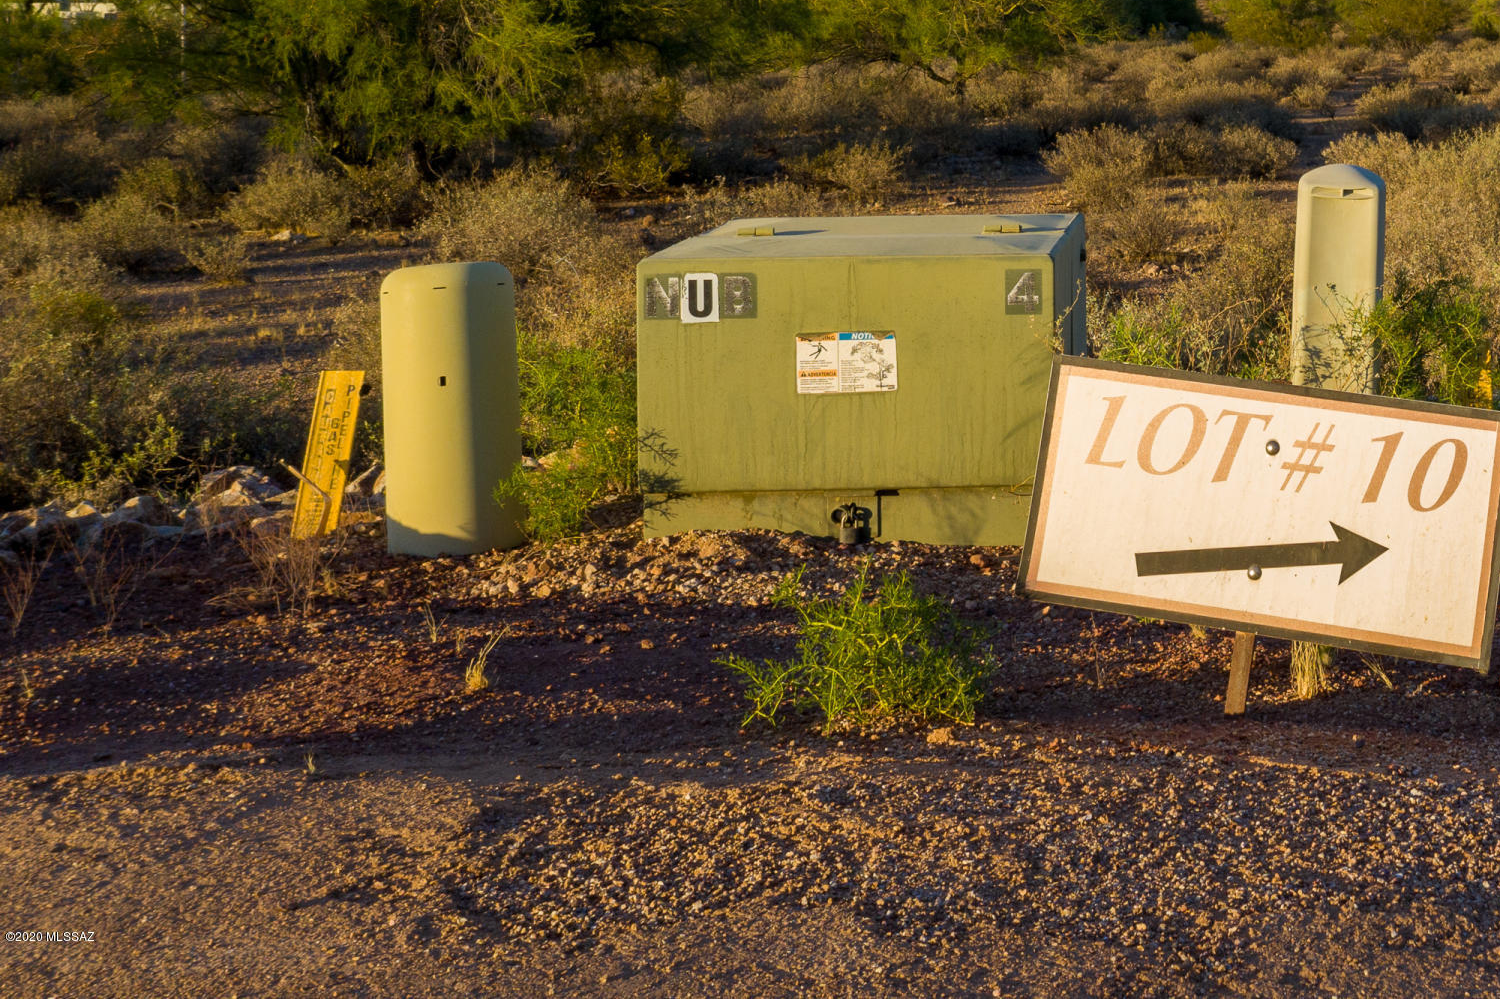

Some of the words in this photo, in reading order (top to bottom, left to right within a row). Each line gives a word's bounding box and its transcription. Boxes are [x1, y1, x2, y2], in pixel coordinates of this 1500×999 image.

[647, 276, 752, 318] NUB
[1008, 272, 1038, 313] 4
[851, 332, 876, 340] NOTI
[326, 418, 341, 455] GAS
[1085, 395, 1273, 482] LOT
[1281, 422, 1335, 492] #
[1361, 431, 1468, 512] 10
